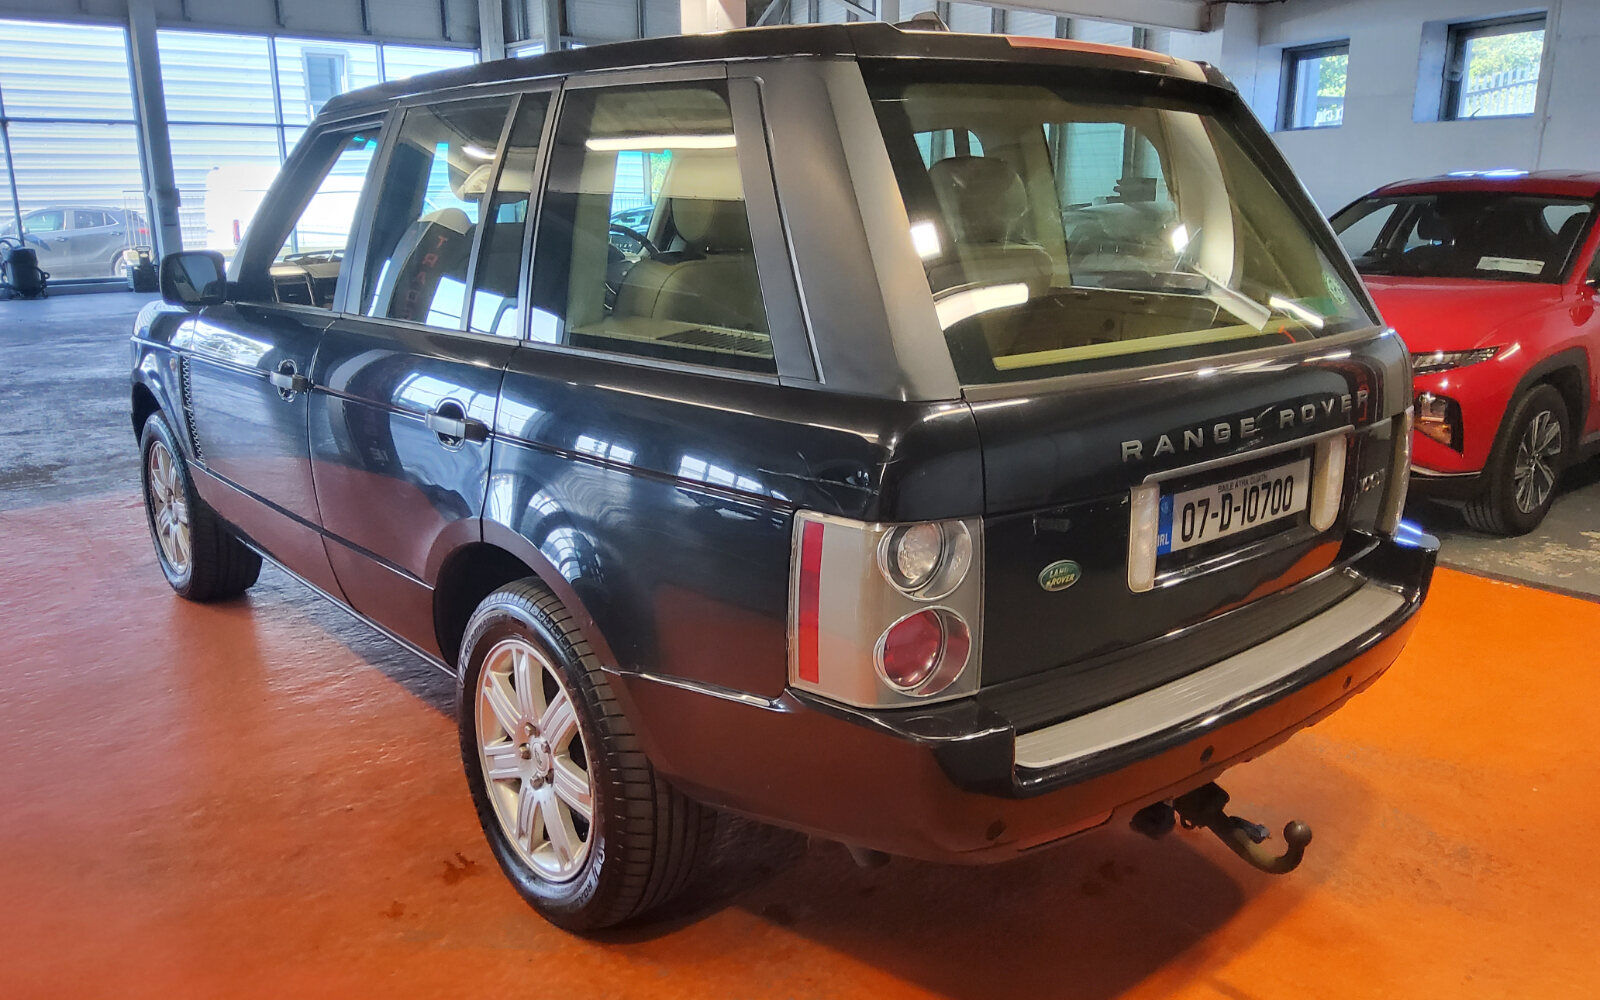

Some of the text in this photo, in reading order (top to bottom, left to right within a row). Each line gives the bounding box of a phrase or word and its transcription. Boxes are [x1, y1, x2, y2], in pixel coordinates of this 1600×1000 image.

[1121, 417, 1258, 462] RANGE
[1280, 390, 1369, 429] ROVER
[1182, 475, 1294, 543] 07-D-10700
